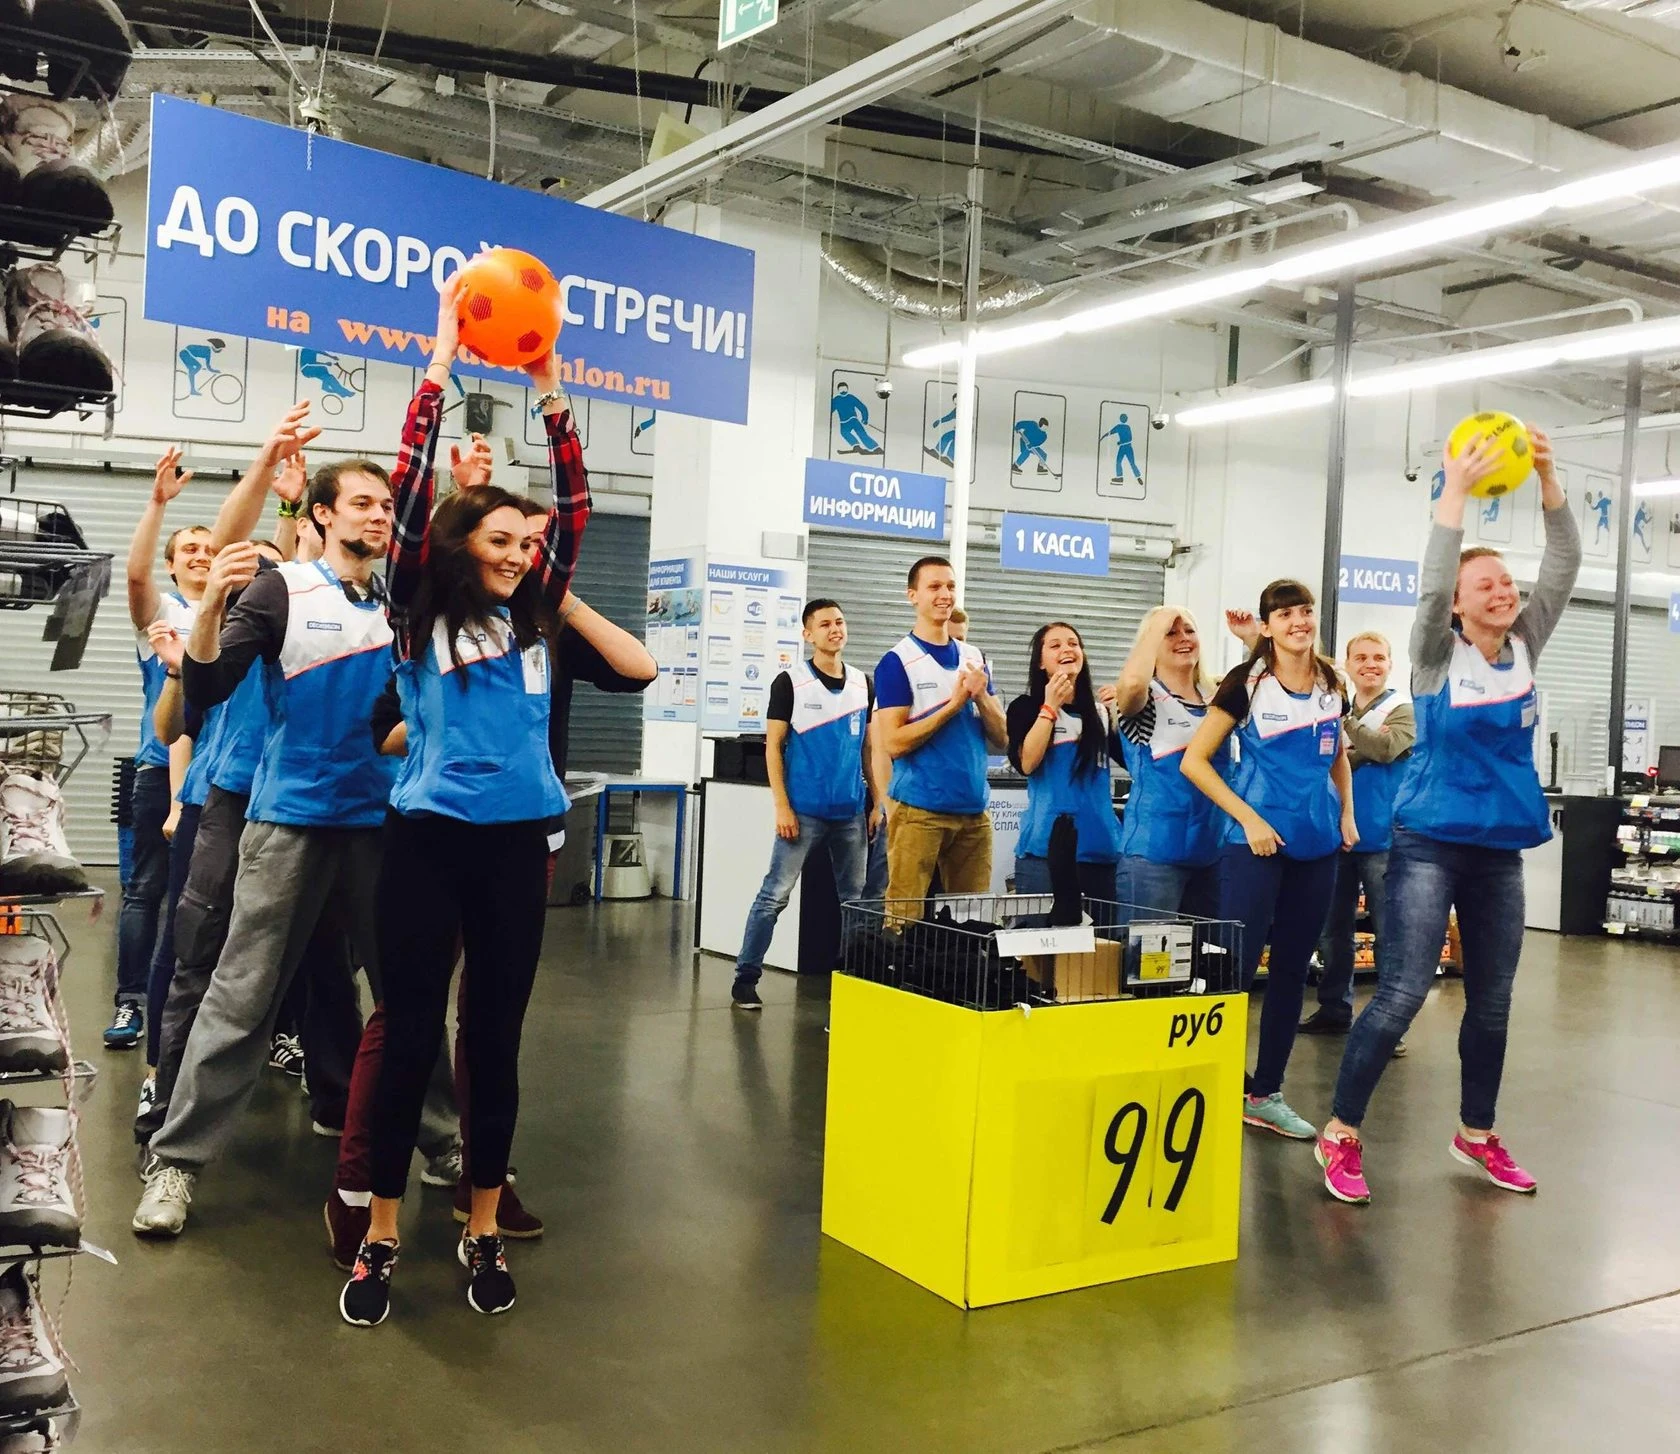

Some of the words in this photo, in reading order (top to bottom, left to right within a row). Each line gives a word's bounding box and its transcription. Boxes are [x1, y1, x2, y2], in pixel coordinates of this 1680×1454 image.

[157, 185, 258, 257] ДО
[278, 210, 502, 294] СКОРО
[557, 274, 747, 360] СТРЕЧИ!
[266, 306, 311, 335] на
[849, 471, 901, 500] СТОЛ
[810, 495, 936, 530] ИНФОРМАЦИИ
[1015, 528, 1025, 553] 1
[1032, 531, 1095, 560] КАССА
[708, 568, 737, 579] НАШИ
[737, 570, 770, 583] УСЛУГИ
[1339, 567, 1349, 588] 2
[1353, 568, 1402, 593] КАССА
[1406, 574, 1416, 595] 3
[989, 800, 1012, 810] десь
[991, 811, 1001, 821] ту
[994, 821, 1020, 831] СПЛА
[1168, 1001, 1226, 1048] руб
[1100, 1087, 1205, 1225] 99
